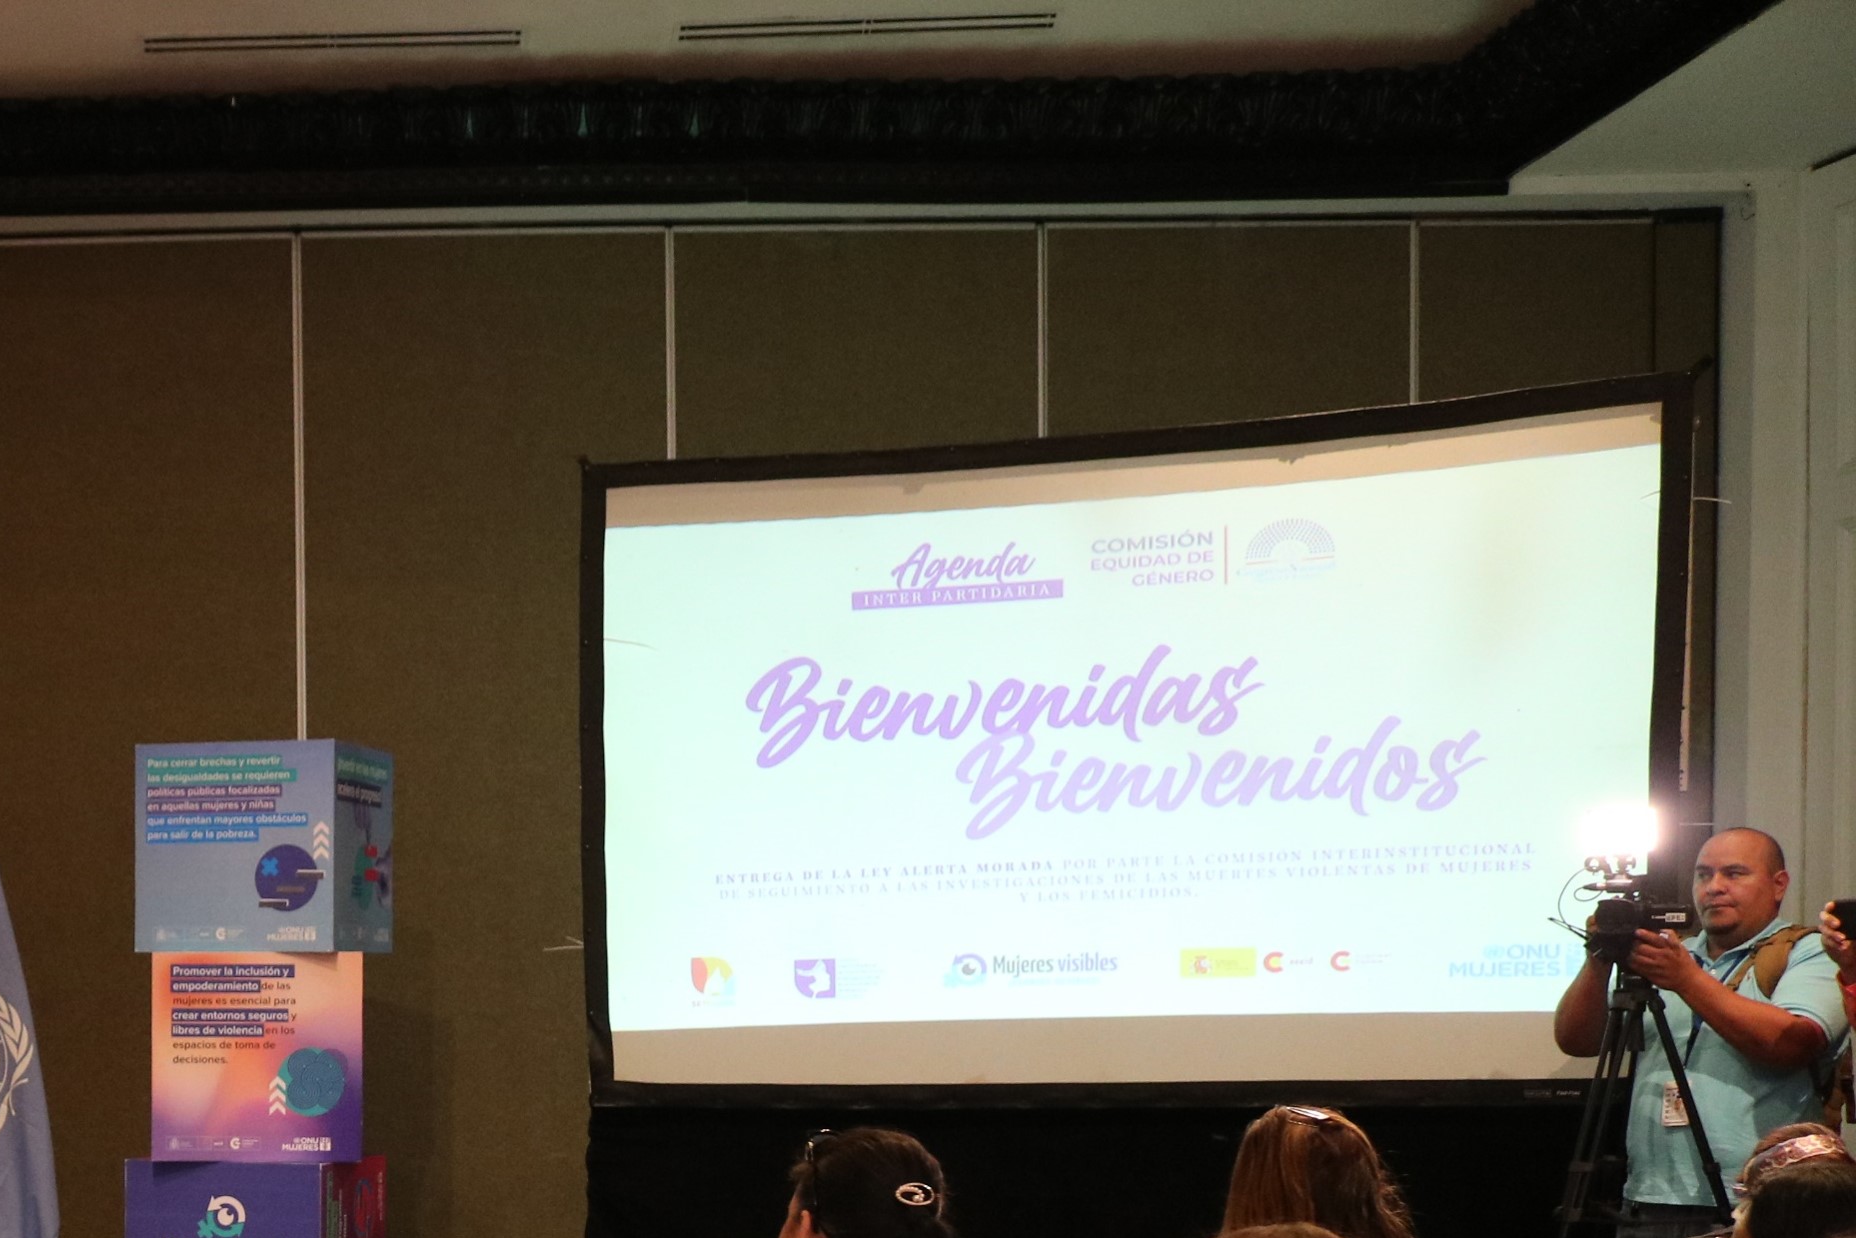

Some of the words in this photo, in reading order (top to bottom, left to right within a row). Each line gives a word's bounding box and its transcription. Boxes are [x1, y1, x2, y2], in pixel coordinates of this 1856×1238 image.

[1090, 529, 1214, 554] COMISIÓN
[891, 541, 1037, 592] Agenda
[1090, 553, 1182, 572] EQUIDAD
[1187, 549, 1215, 565] DE
[1131, 566, 1215, 587] GÉNERO
[862, 592, 924, 608] INTER
[931, 582, 1052, 603] PARTIDARIA
[745, 644, 1265, 769] Bienvenidas
[955, 715, 1488, 841] Bienvenidos
[1506, 943, 1561, 960] ONU
[172, 966, 222, 977] Promover
[223, 966, 233, 976] la
[235, 965, 281, 976] inclusión
[282, 968, 290, 977] y
[993, 955, 1055, 978] Mujeres
[1057, 952, 1119, 973] visibles
[1448, 961, 1561, 978] MUJERES
[172, 980, 259, 992] empoderamiento
[261, 980, 274, 990] de
[276, 980, 291, 990] las
[172, 996, 213, 1006] mujeres
[229, 995, 272, 1005] esencial
[273, 997, 297, 1007] para
[172, 1012, 198, 1020] crear
[200, 1011, 247, 1020] entornos
[248, 1012, 289, 1023] seguros
[291, 1013, 297, 1021] y
[172, 1025, 201, 1035] libres
[202, 1025, 216, 1035] de
[217, 1025, 264, 1035] violencia
[280, 1026, 296, 1035] los
[172, 1041, 217, 1051] espacios
[219, 1040, 233, 1049] de
[235, 1040, 261, 1049] toma
[262, 1039, 276, 1049] de
[172, 1055, 229, 1064] decisiones.
